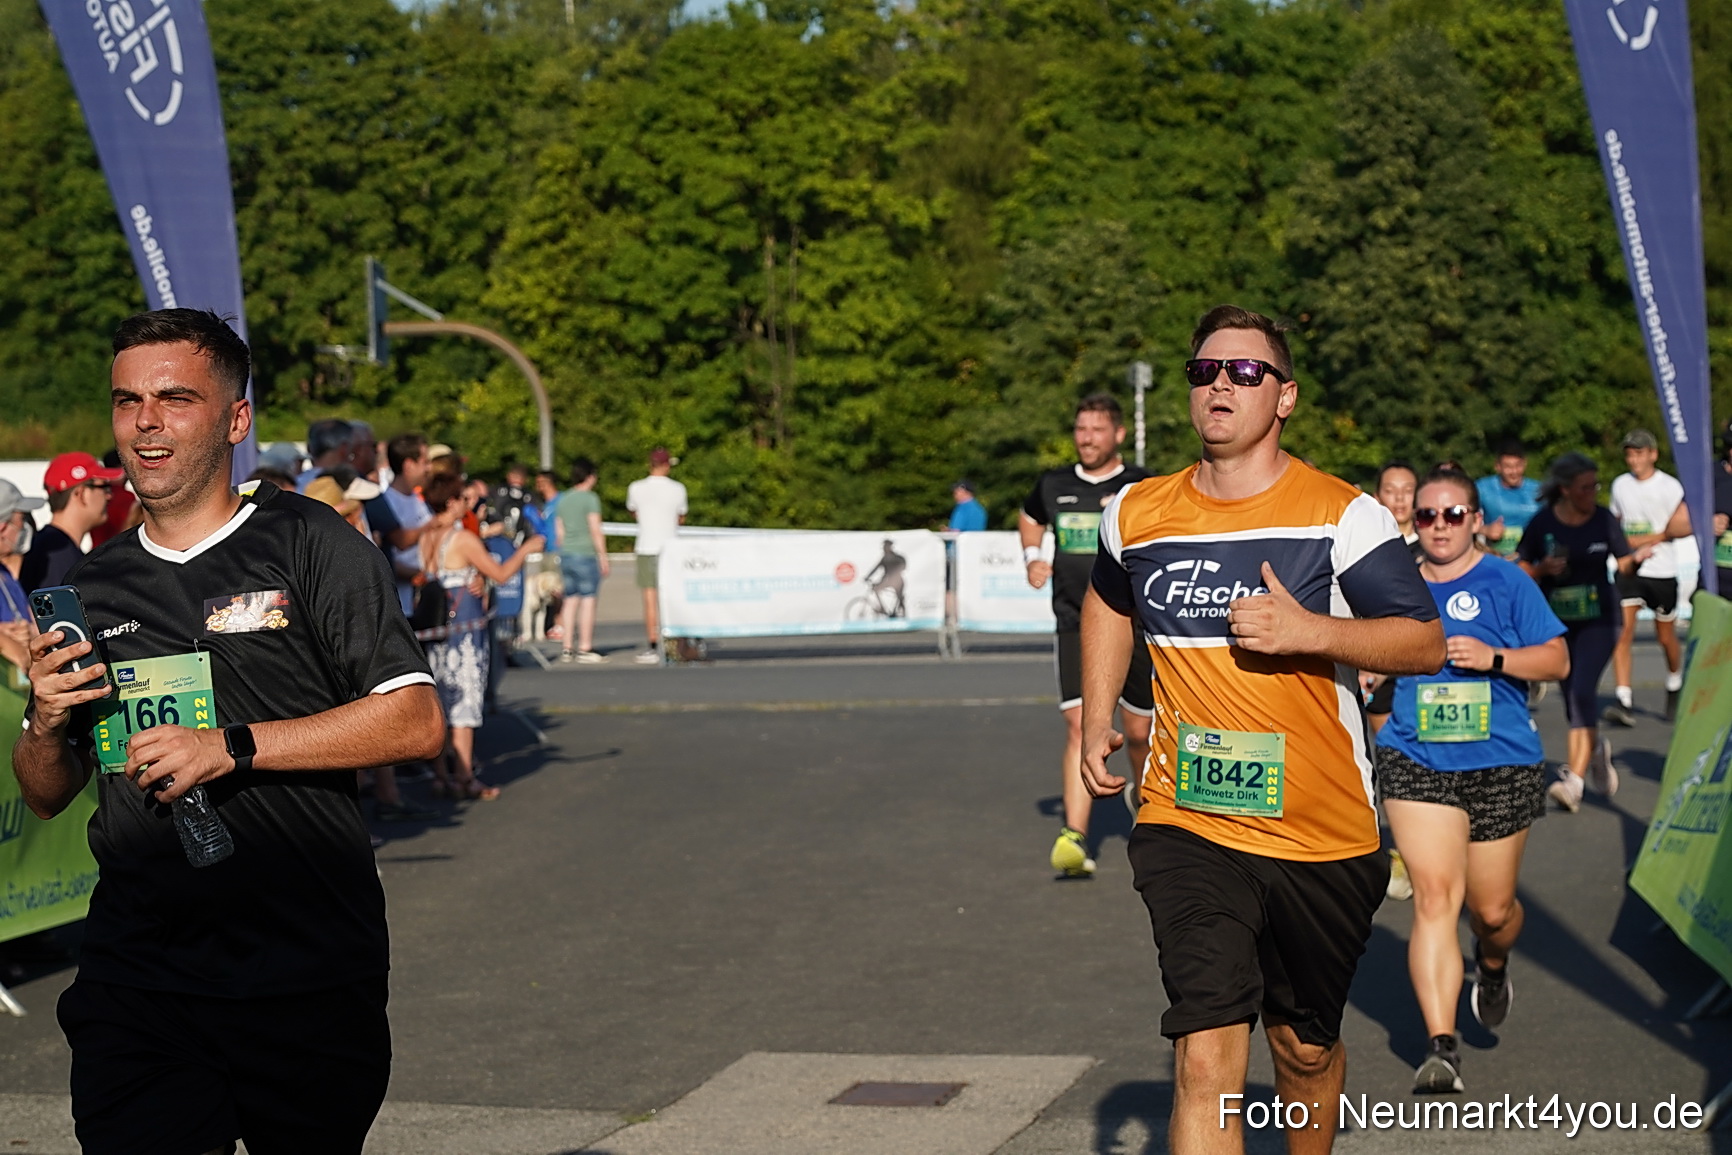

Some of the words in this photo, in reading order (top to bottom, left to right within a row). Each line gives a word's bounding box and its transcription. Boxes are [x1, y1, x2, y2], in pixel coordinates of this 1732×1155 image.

[97, 623, 130, 641] CRAFT
[118, 695, 180, 734] 166
[1433, 703, 1470, 722] 431
[98, 715, 111, 752] RUN
[1181, 761, 1190, 791] RUN
[1192, 755, 1264, 788] 1842
[1267, 766, 1278, 805] 2022
[1194, 785, 1234, 799] Mrowetz
[1237, 790, 1259, 801] Dirk
